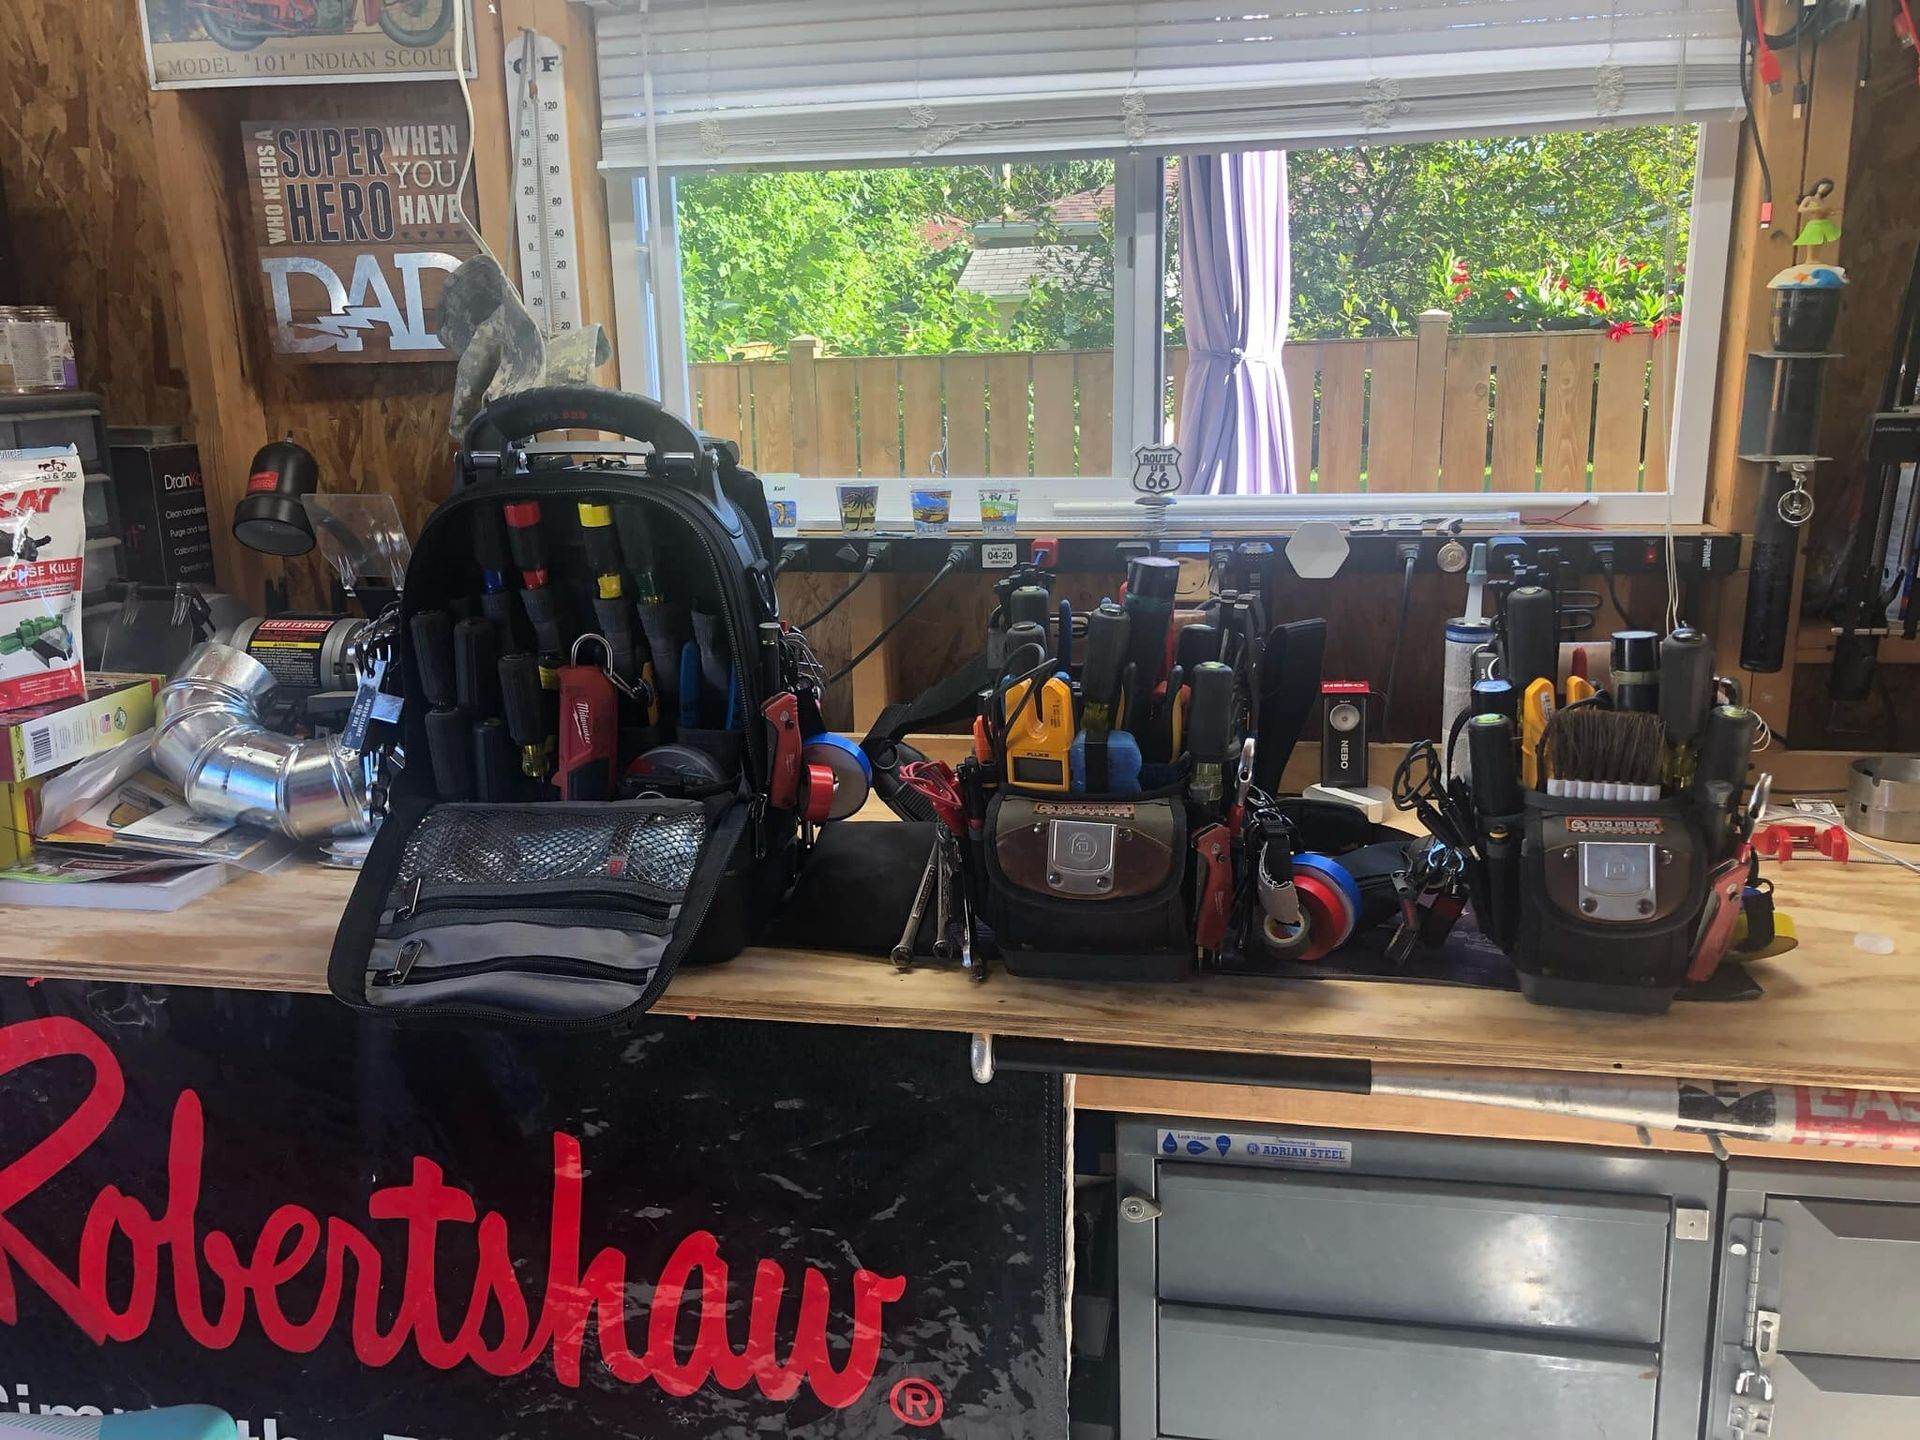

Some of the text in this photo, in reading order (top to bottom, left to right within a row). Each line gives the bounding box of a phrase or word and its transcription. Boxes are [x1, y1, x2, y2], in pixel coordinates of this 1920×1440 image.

[168, 57, 237, 76] MODEL
[305, 50, 376, 70] INDIAN
[384, 47, 455, 68] SCOUT
[541, 56, 559, 73] F
[544, 101, 557, 110] 120
[386, 125, 458, 157] WHEN
[546, 133, 559, 142] 100
[277, 126, 389, 179] SUPER
[522, 157, 532, 167] 30
[390, 160, 457, 189] YOU
[549, 165, 560, 175] 80
[254, 129, 287, 245] WHO NEEDS A
[524, 186, 534, 195] 20
[552, 197, 562, 206] 60
[285, 180, 395, 243] HERO
[398, 193, 461, 225] HAVE
[526, 214, 537, 223] 10
[554, 229, 565, 238] 40
[528, 242, 534, 251] 0
[557, 260, 567, 269] 20
[531, 270, 541, 278] 10
[262, 252, 464, 353] DAD
[532, 297, 542, 306] 20
[561, 321, 571, 330] 20
[1143, 453, 1173, 463] ROUTE
[1146, 472, 1170, 489] 66
[988, 551, 1013, 560] 04-20
[1702, 538, 1712, 568] PRIME
[265, 621, 327, 629] CRAFTSMAN
[576, 702, 592, 745] Milwaukee
[1340, 740, 1350, 770] NEBO
[1263, 1145, 1345, 1160] ADRIAN STEEL
[0, 1016, 907, 1409] Robertshaw
